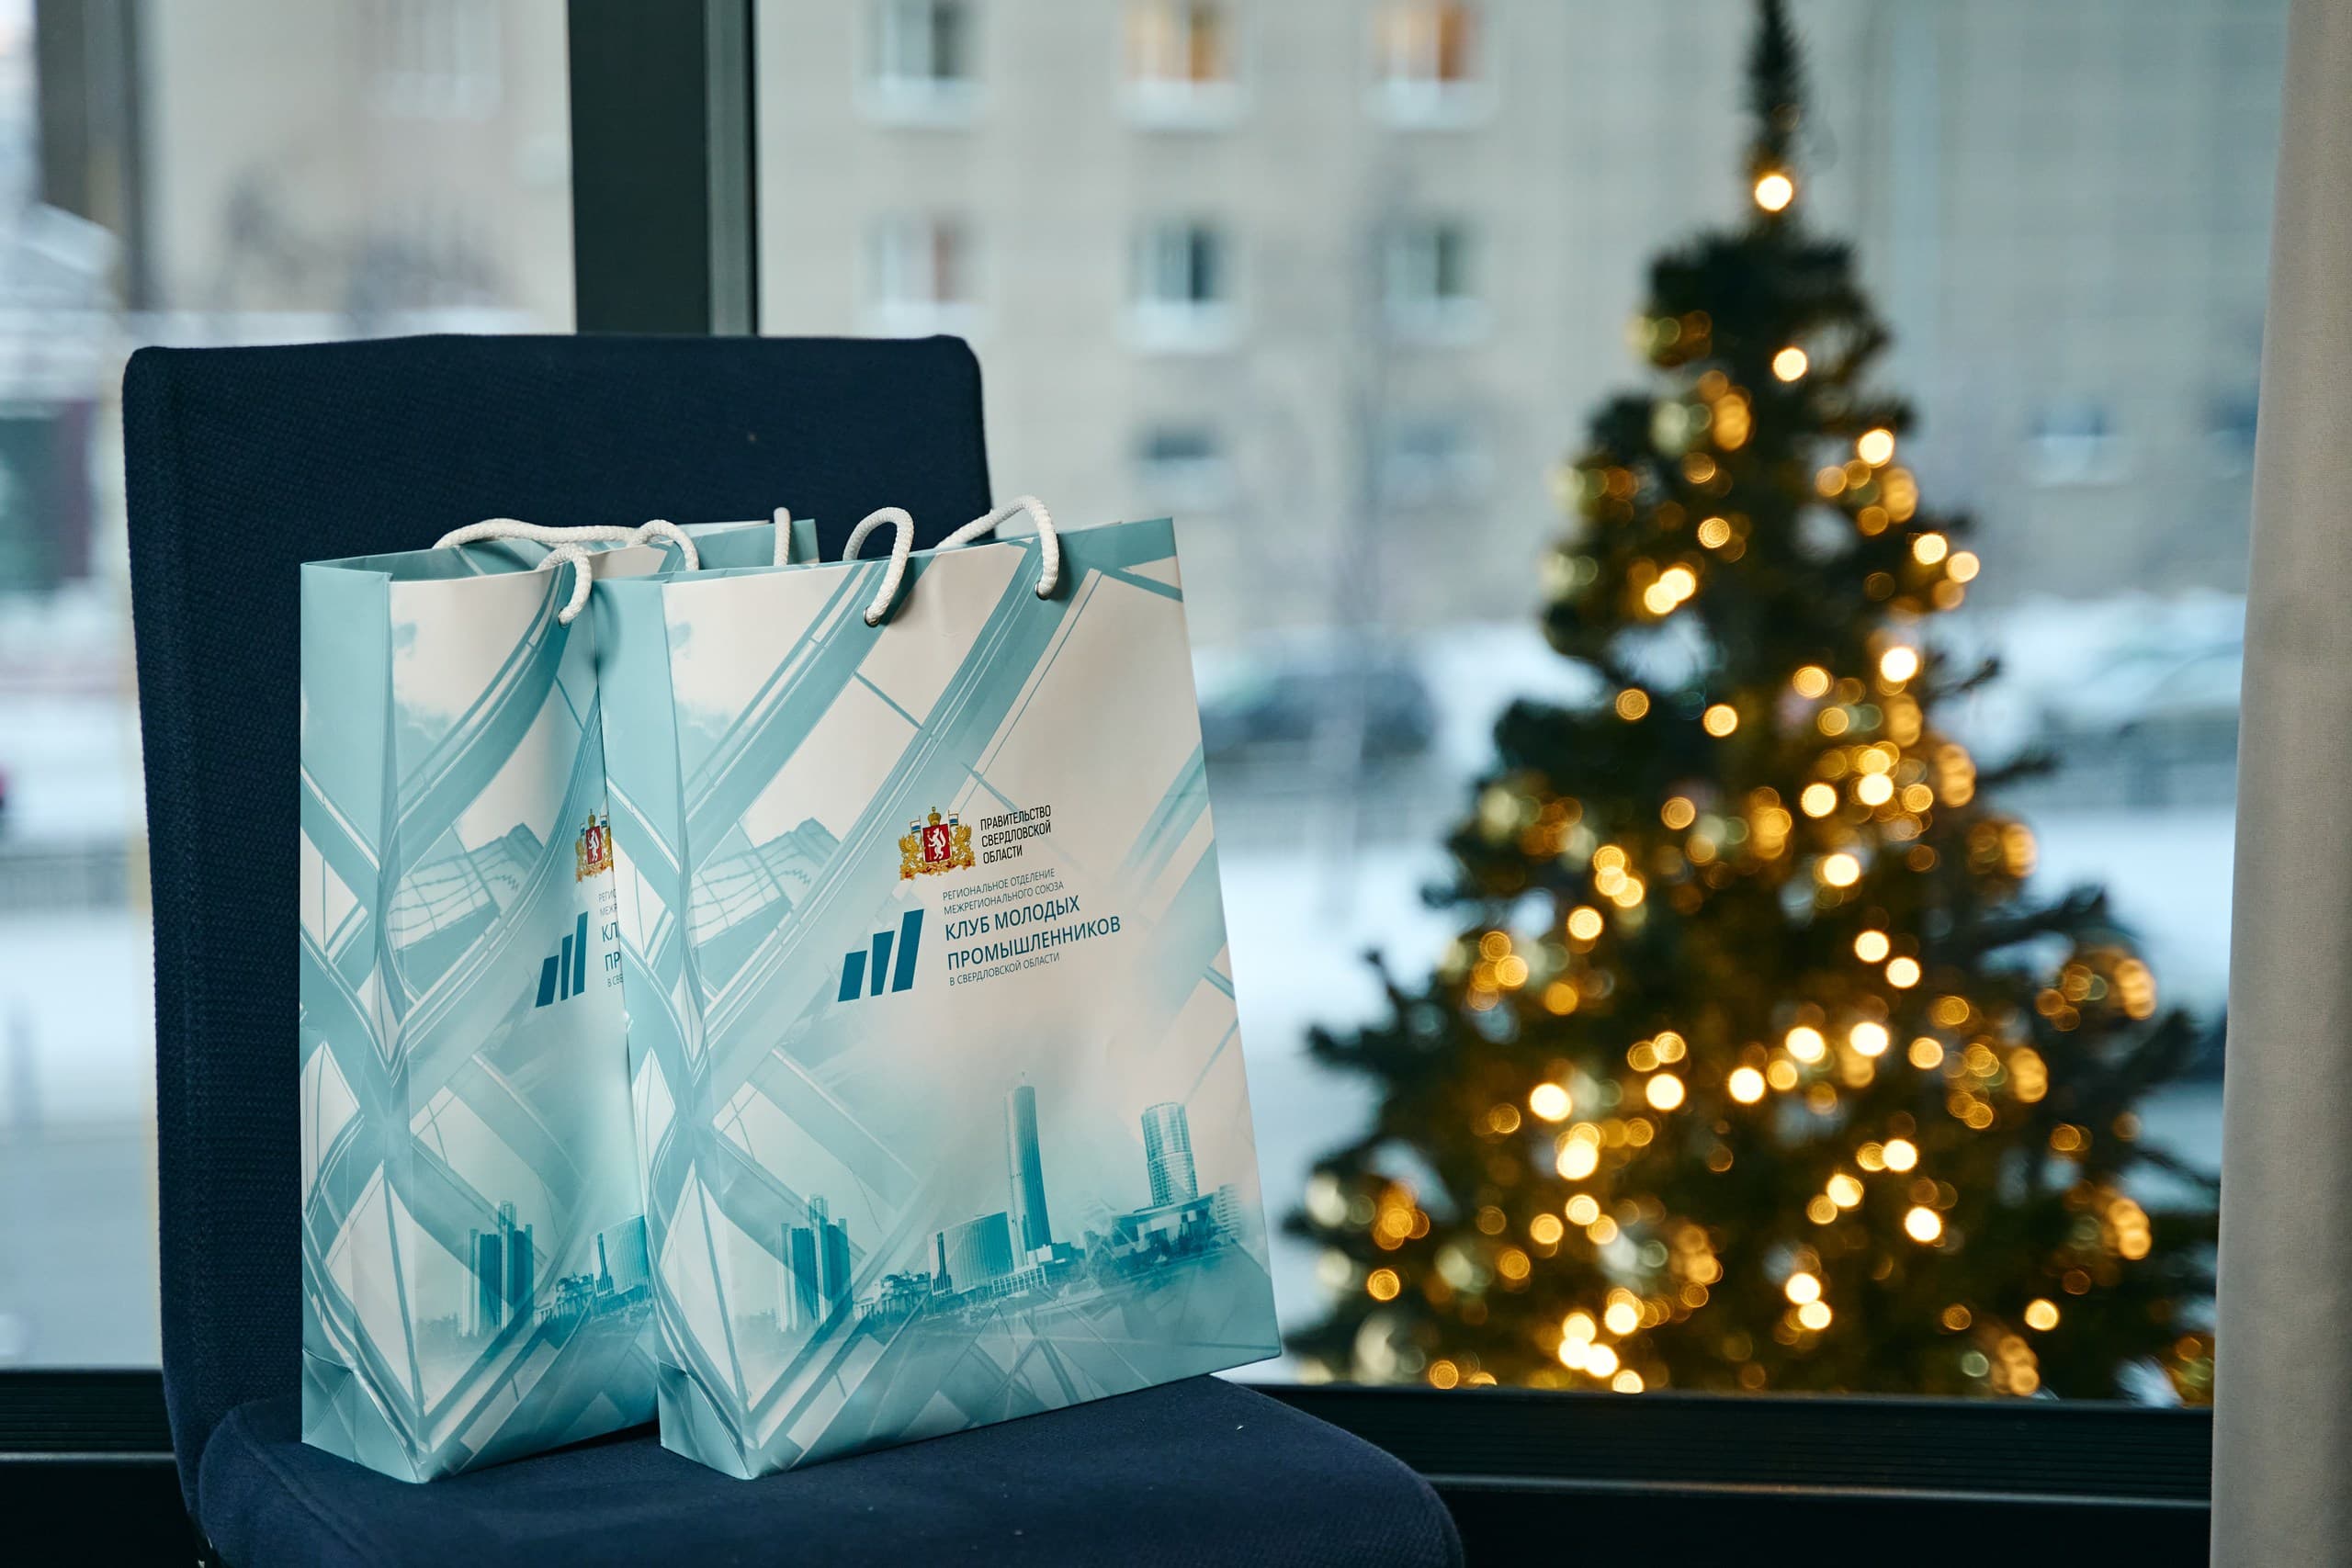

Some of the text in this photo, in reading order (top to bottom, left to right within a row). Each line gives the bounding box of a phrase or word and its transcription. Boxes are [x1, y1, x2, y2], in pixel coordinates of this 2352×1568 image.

[980, 805, 1051, 830] ПРАВИТЕЛЬСТВО
[981, 819, 1051, 847] СВЕРДЛОВСКОЙ
[983, 845, 1023, 863] ОБЛАСТИ
[943, 868, 1056, 901] РЕГИОНАЛЬНОЕ ОТДЕЛЕНИЕ
[944, 881, 1065, 915] МЕЖРЕГИОНАЛЬНОГО СОЮЗА
[945, 895, 1080, 941] КЛУБ МОЛОДЫХ
[947, 916, 1121, 970] ПРОМЫШЛЕННИКОВ
[949, 953, 1059, 986] В СВЕРДЛОВСКОЙ ОБЛАСТИ
